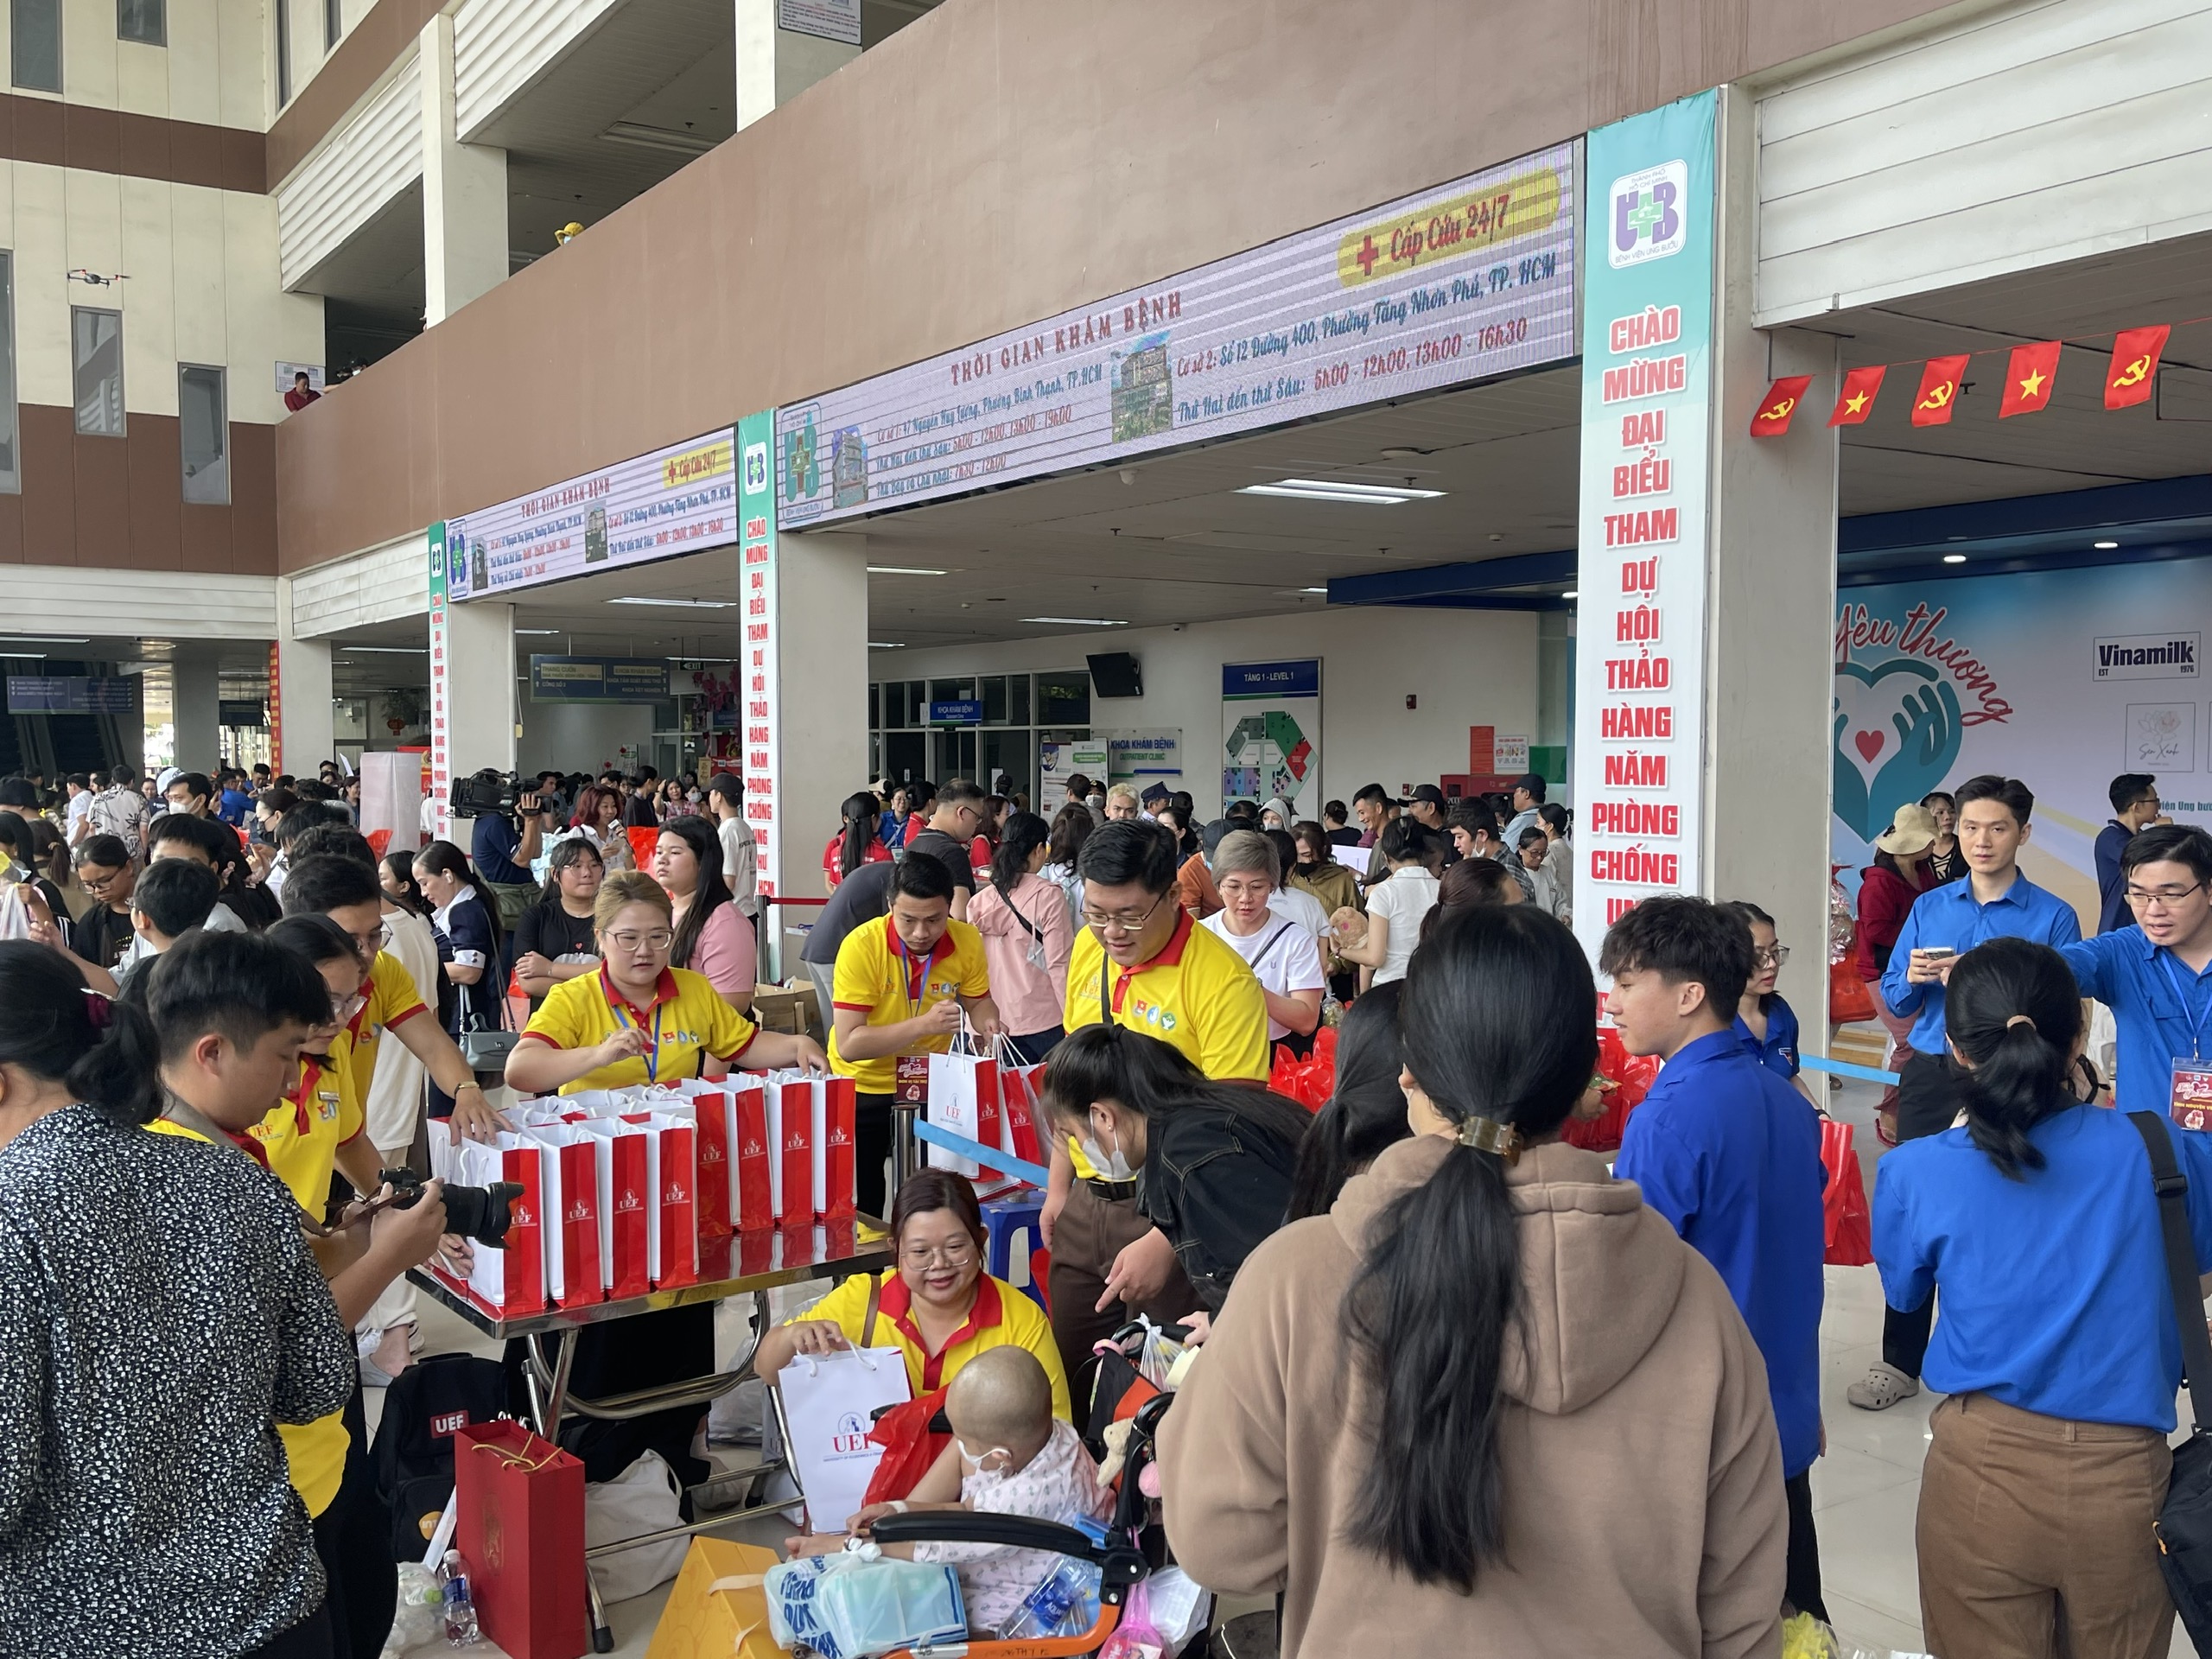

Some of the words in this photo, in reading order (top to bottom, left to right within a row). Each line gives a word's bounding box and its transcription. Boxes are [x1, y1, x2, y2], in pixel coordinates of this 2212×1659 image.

[1390, 220, 1423, 266] Cấp
[1427, 214, 1462, 250] Cứu
[1465, 194, 1509, 243] 24/7
[1236, 340, 1248, 363] 12
[1251, 332, 1288, 358] Đường
[1322, 309, 1370, 338] Phường
[1410, 287, 1448, 315] Nhơn
[1518, 251, 1556, 286] HCM
[951, 353, 991, 385] THỜI
[1001, 335, 1044, 370] GIAN
[1055, 314, 1112, 353] KHÁM
[1124, 291, 1181, 332] BỆNH
[1611, 305, 1679, 352] CHÀO
[1604, 359, 1686, 403] MỪNG
[1622, 410, 1664, 452] ĐẠI
[1612, 448, 1669, 498] BIỂU
[747, 517, 766, 538] CHÀO
[1604, 507, 1677, 546] THAM
[746, 543, 768, 565] MỪNG
[1621, 556, 1658, 598] DỰ
[747, 623, 768, 642] THAM
[1616, 604, 1660, 647] HỘI
[2099, 640, 2194, 667] Vinamilk
[1244, 672, 1261, 682] TẦNG
[1270, 672, 1289, 681] LEVEL
[1605, 648, 1669, 690] THẢO
[2098, 668, 2108, 677] EST
[2180, 664, 2195, 673] 1976
[752, 673, 765, 695] HỘI
[749, 693, 768, 718] THẢO
[1601, 702, 1672, 739] HÀNG
[748, 724, 769, 745] HÀNG
[1110, 741, 1130, 749] KHOA
[1131, 736, 1153, 749] KHÁM
[1154, 736, 1175, 750] BỆNH
[750, 749, 768, 769] NĂM
[1120, 753, 1147, 761] OUTPATIENT
[1605, 750, 1666, 786] NĂM
[747, 775, 772, 796] PHÒNG
[747, 798, 772, 821] CHỐNG
[1592, 798, 1678, 836] PHÒNG
[1591, 842, 1678, 886] CHỐNG
[946, 1106, 961, 1120] UEF
[744, 1145, 761, 1155] UEF
[788, 1139, 804, 1148] UEF
[830, 1135, 848, 1143] UEF
[620, 1198, 639, 1210] UEF
[666, 1192, 685, 1202] UEF
[512, 1214, 532, 1225] UEF
[569, 1208, 589, 1219] UEF
[435, 1414, 464, 1433] UEF
